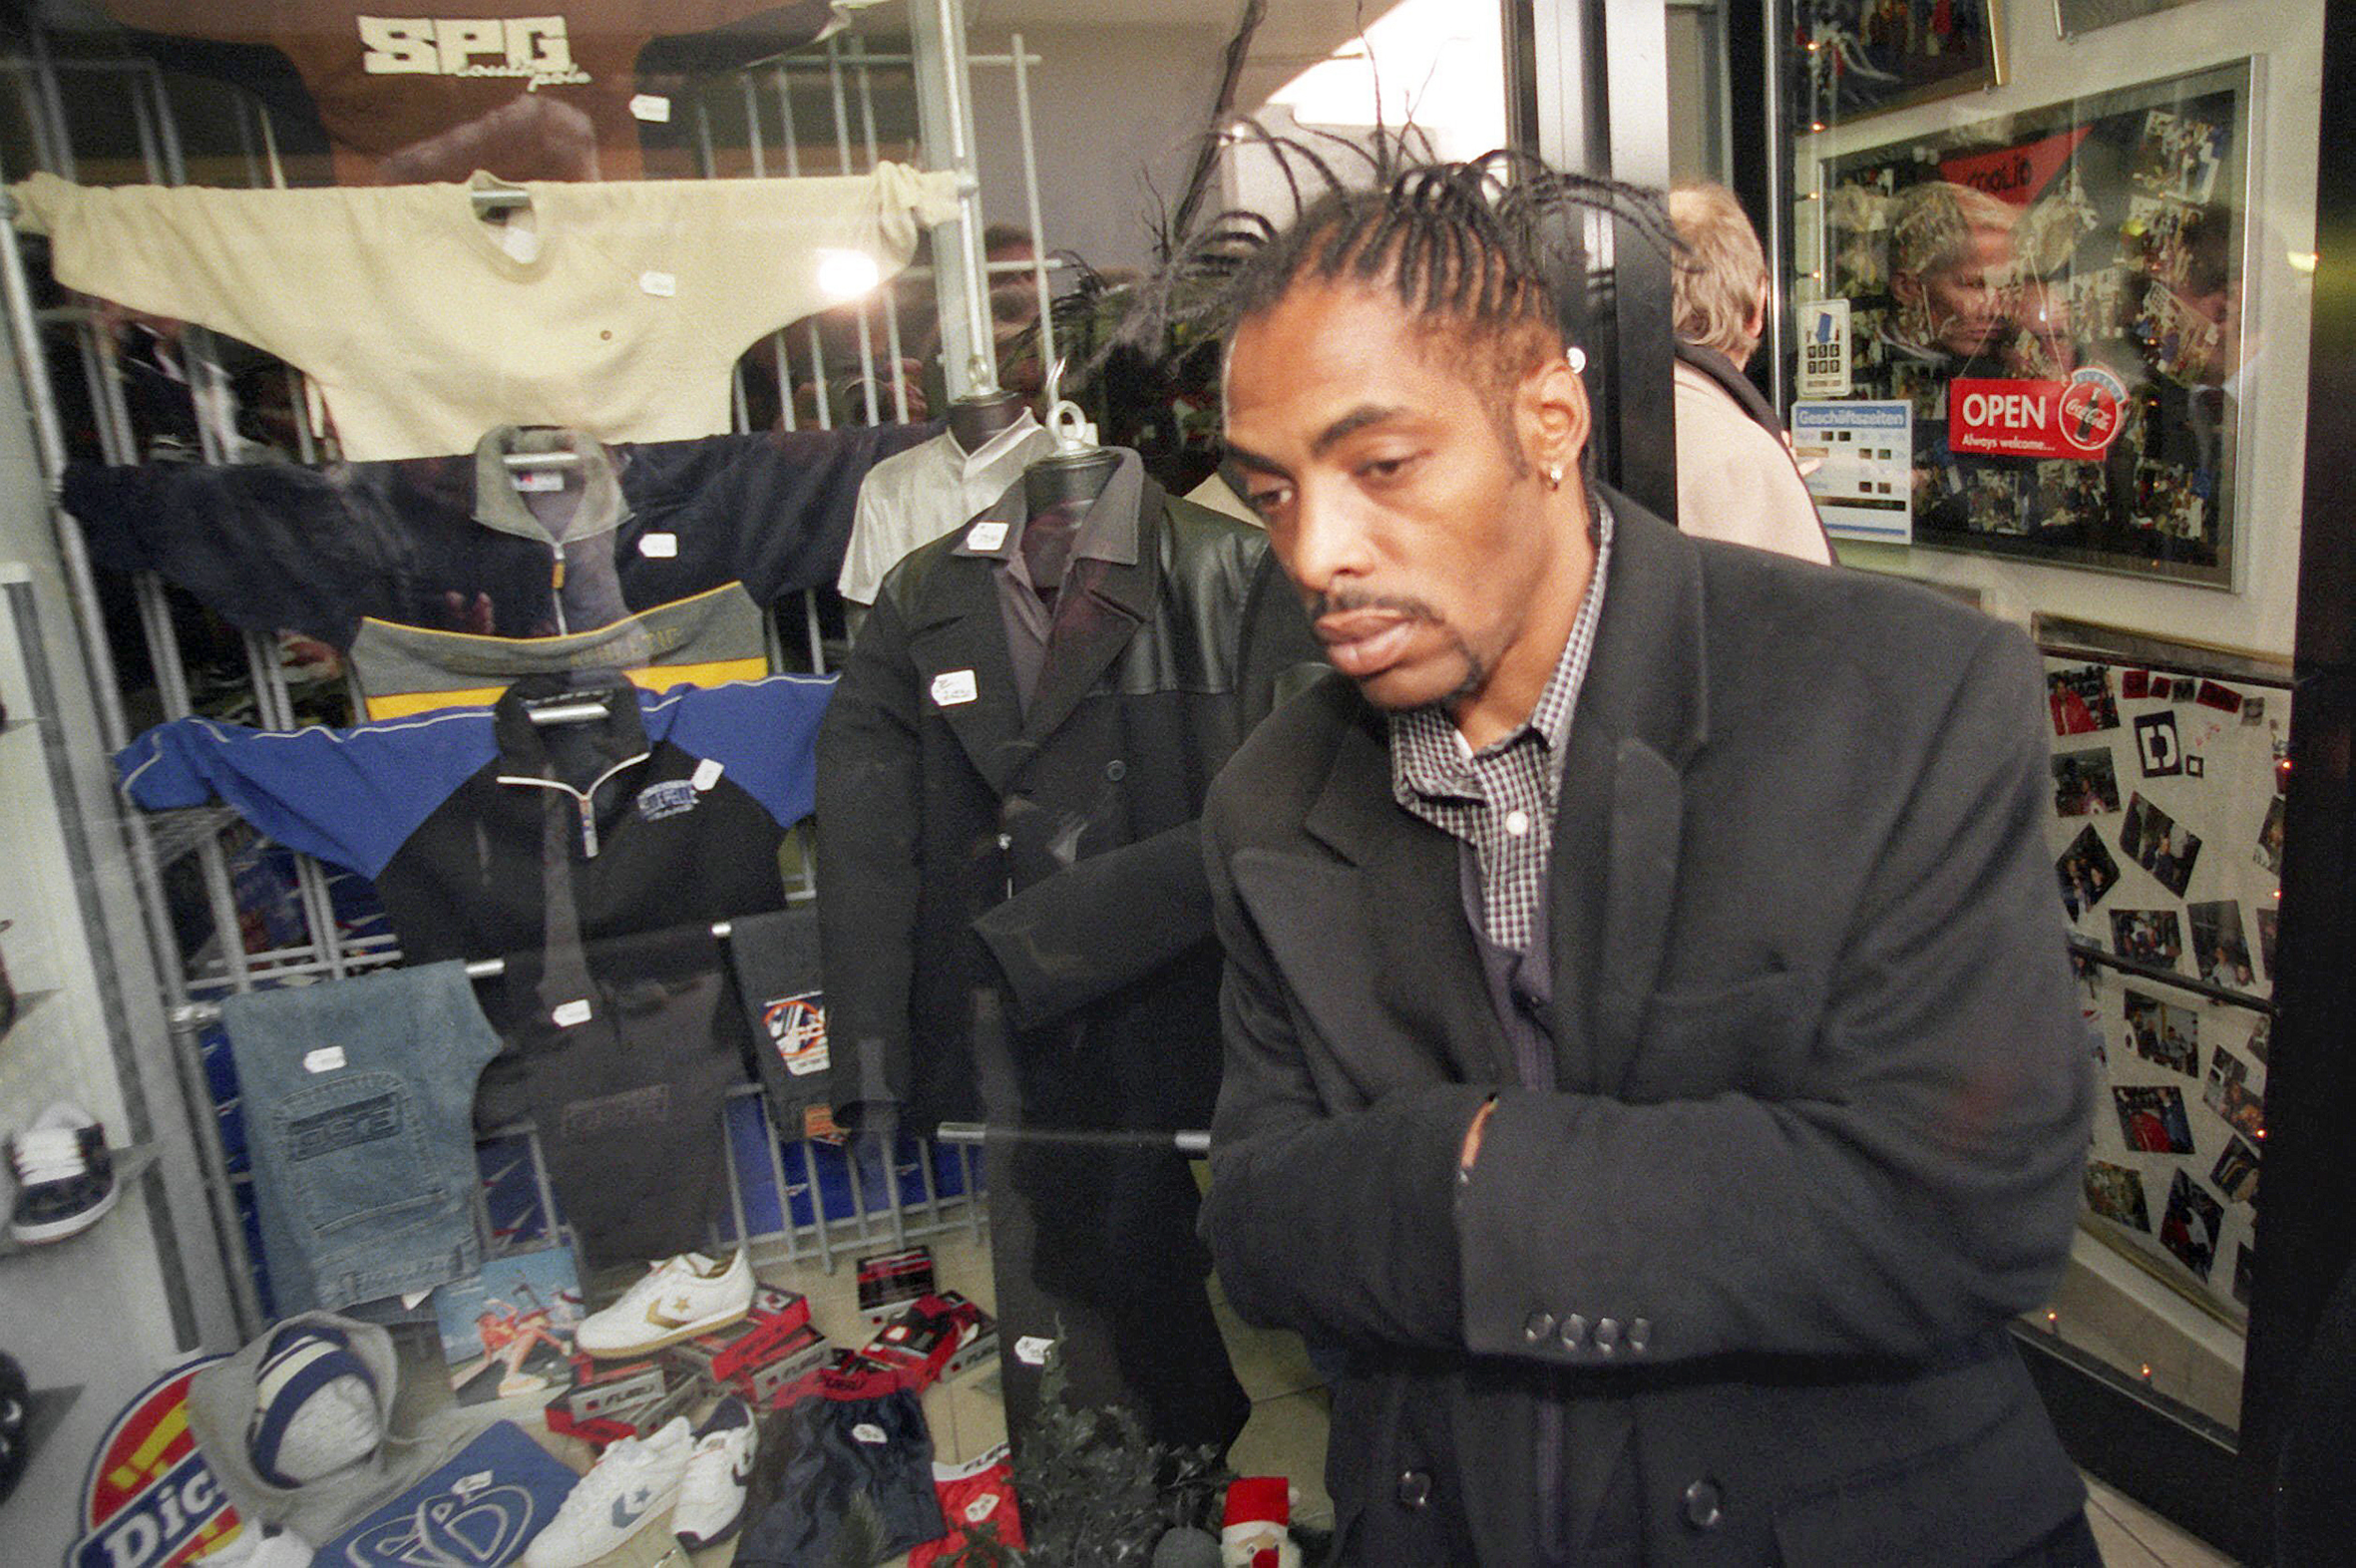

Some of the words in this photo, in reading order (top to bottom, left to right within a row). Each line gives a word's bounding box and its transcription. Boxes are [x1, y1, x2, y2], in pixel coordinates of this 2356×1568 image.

[356, 15, 571, 75] SPG
[1799, 410, 1904, 427] Geschäftszeiten
[1962, 393, 2046, 430] OPEN
[1962, 433, 1998, 451] Always
